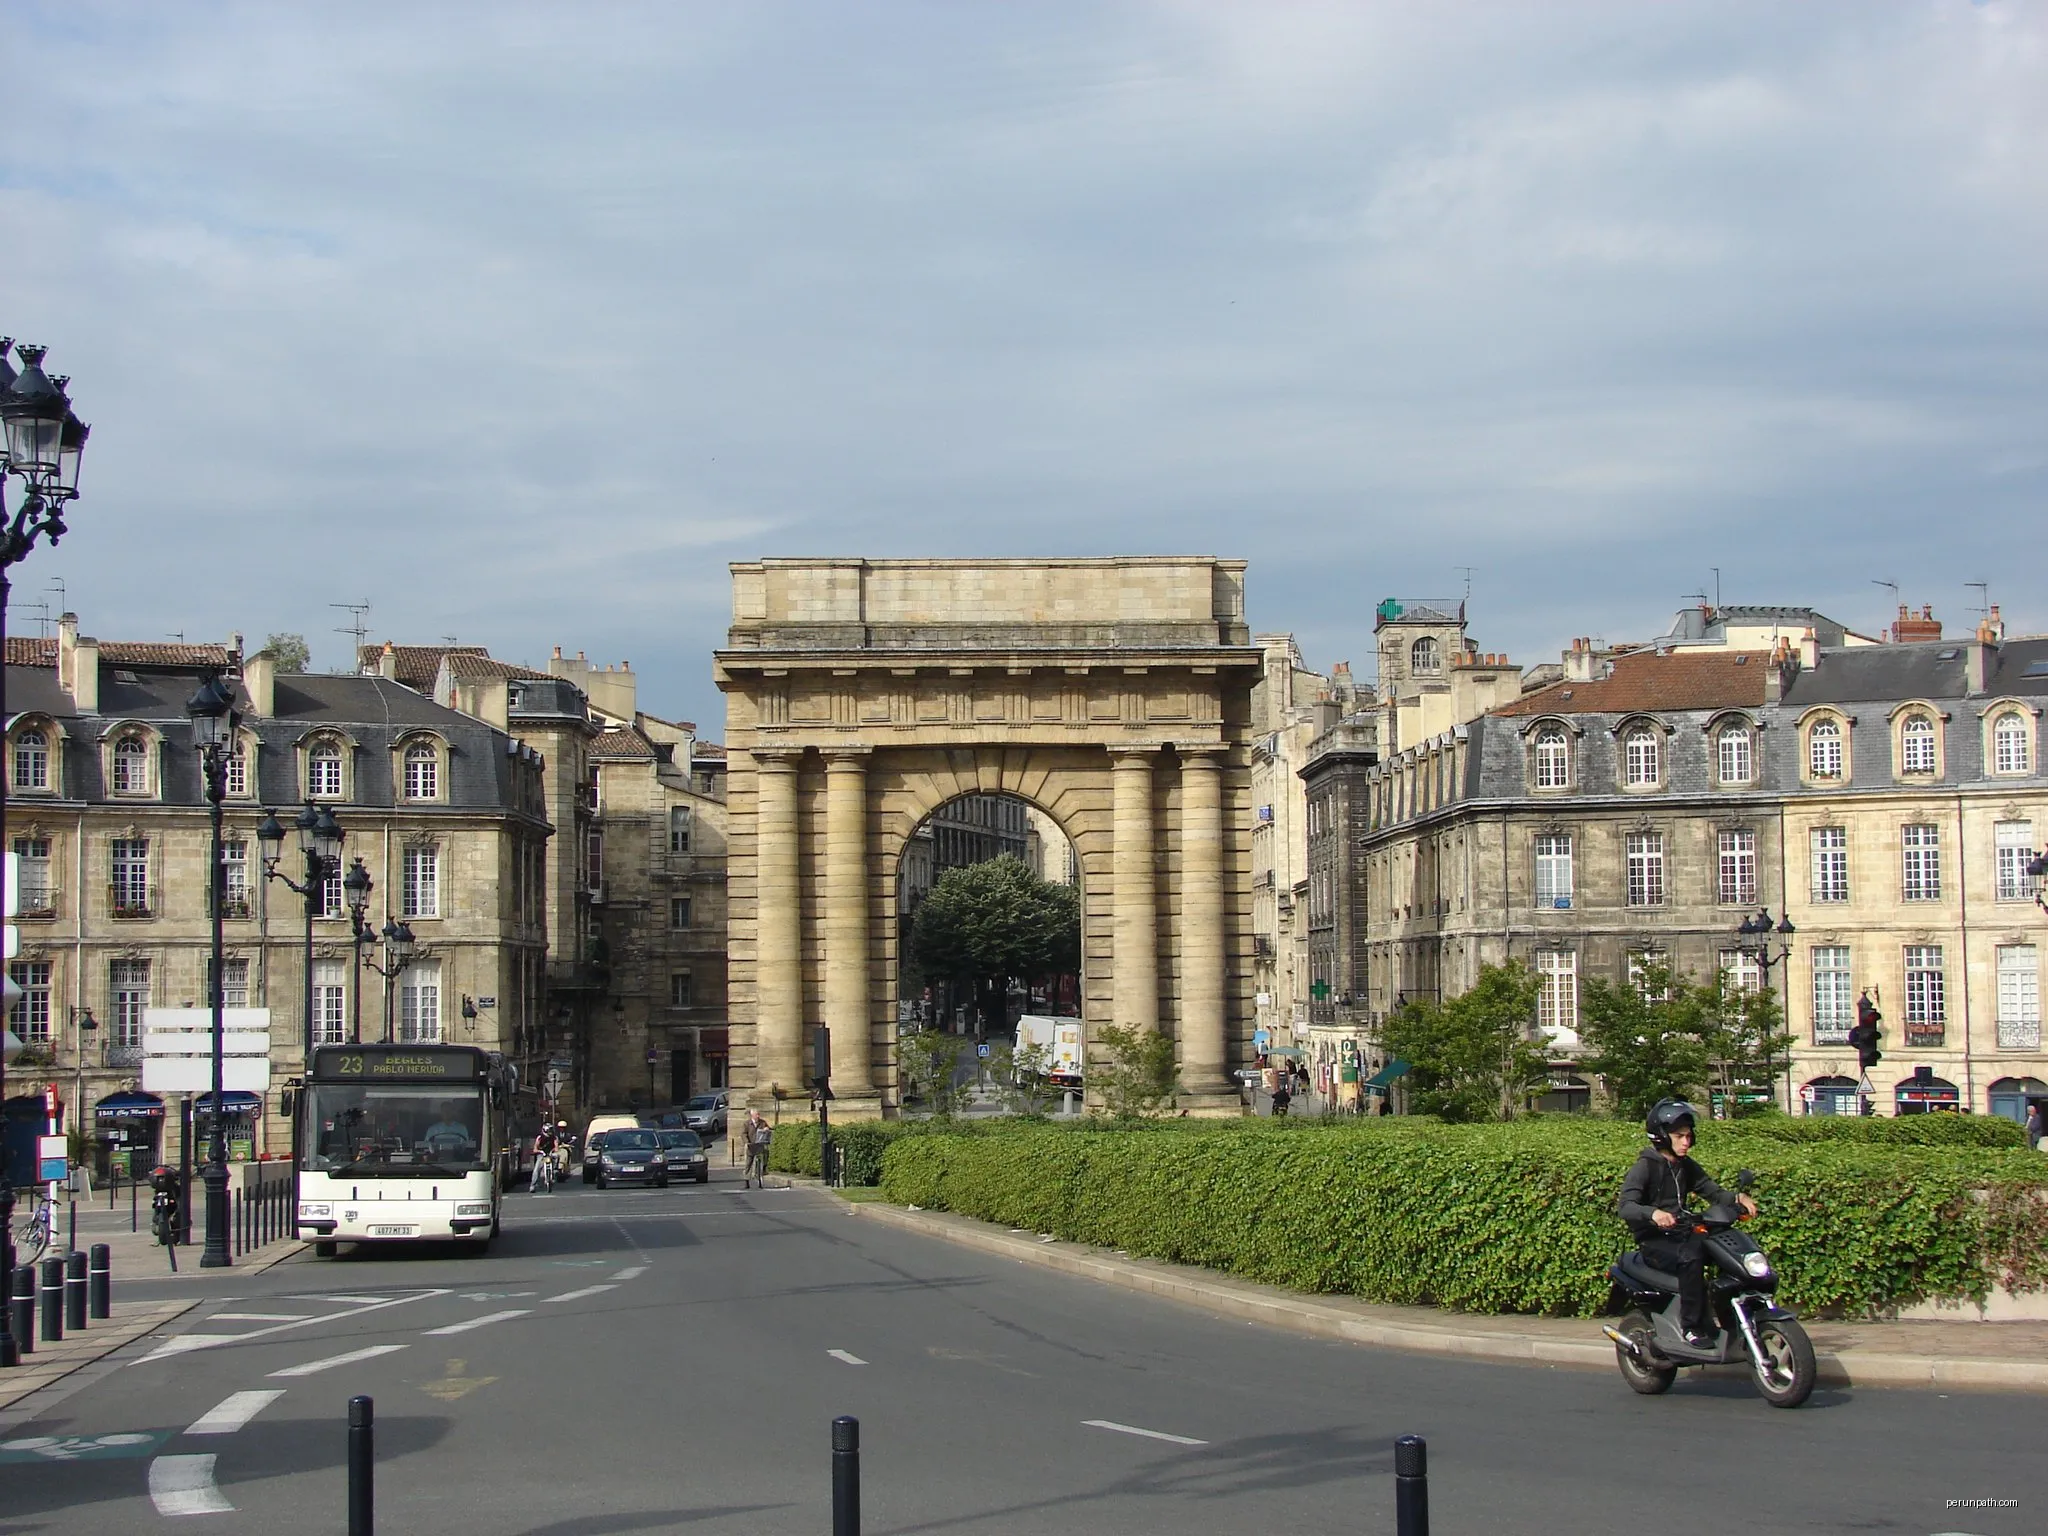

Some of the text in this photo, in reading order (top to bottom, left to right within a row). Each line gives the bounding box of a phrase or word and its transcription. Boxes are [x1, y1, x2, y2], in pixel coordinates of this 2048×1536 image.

[340, 1056, 363, 1073] 23
[373, 1065, 445, 1073] PABLO NERUDA
